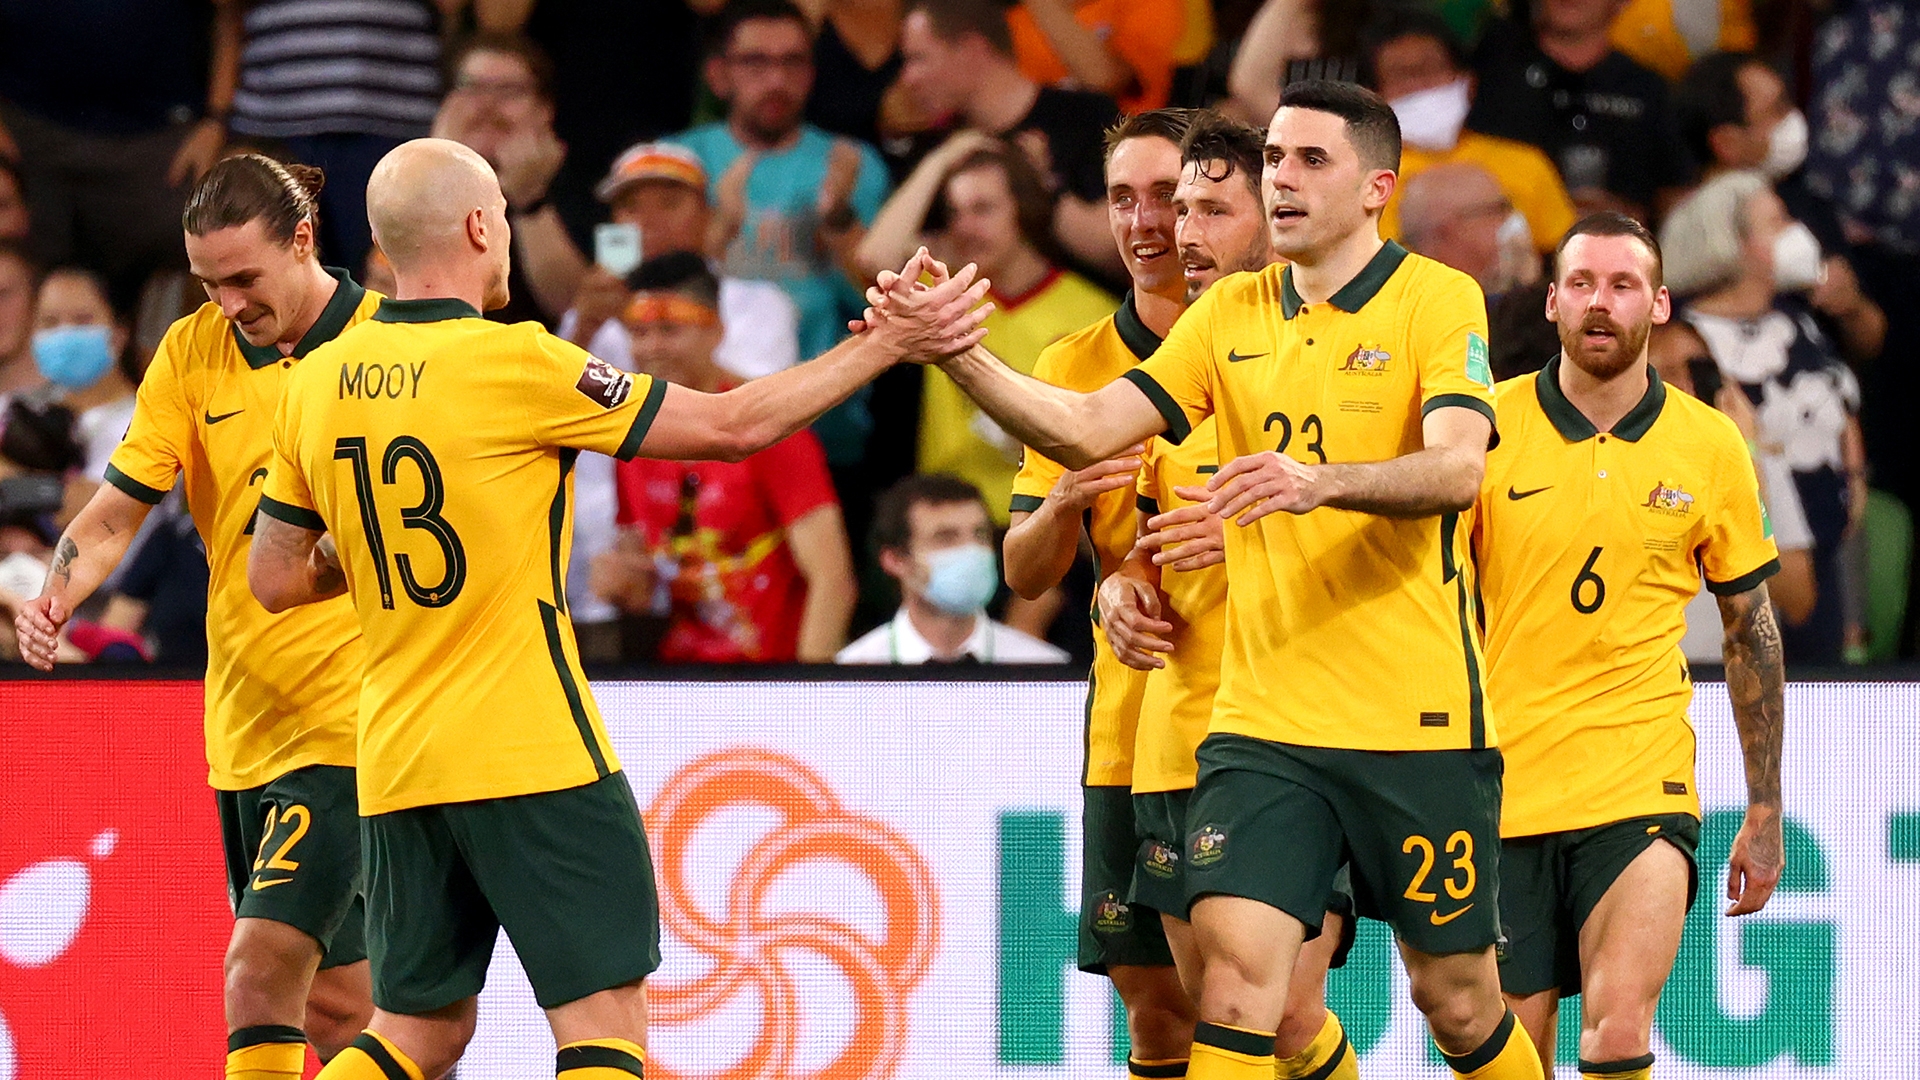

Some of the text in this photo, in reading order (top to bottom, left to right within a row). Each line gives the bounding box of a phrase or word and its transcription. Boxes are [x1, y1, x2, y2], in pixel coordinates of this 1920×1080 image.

[339, 360, 426, 400] MOOY
[333, 435, 467, 610] 13
[1571, 546, 1606, 615] 6
[1402, 830, 1477, 903] 23
